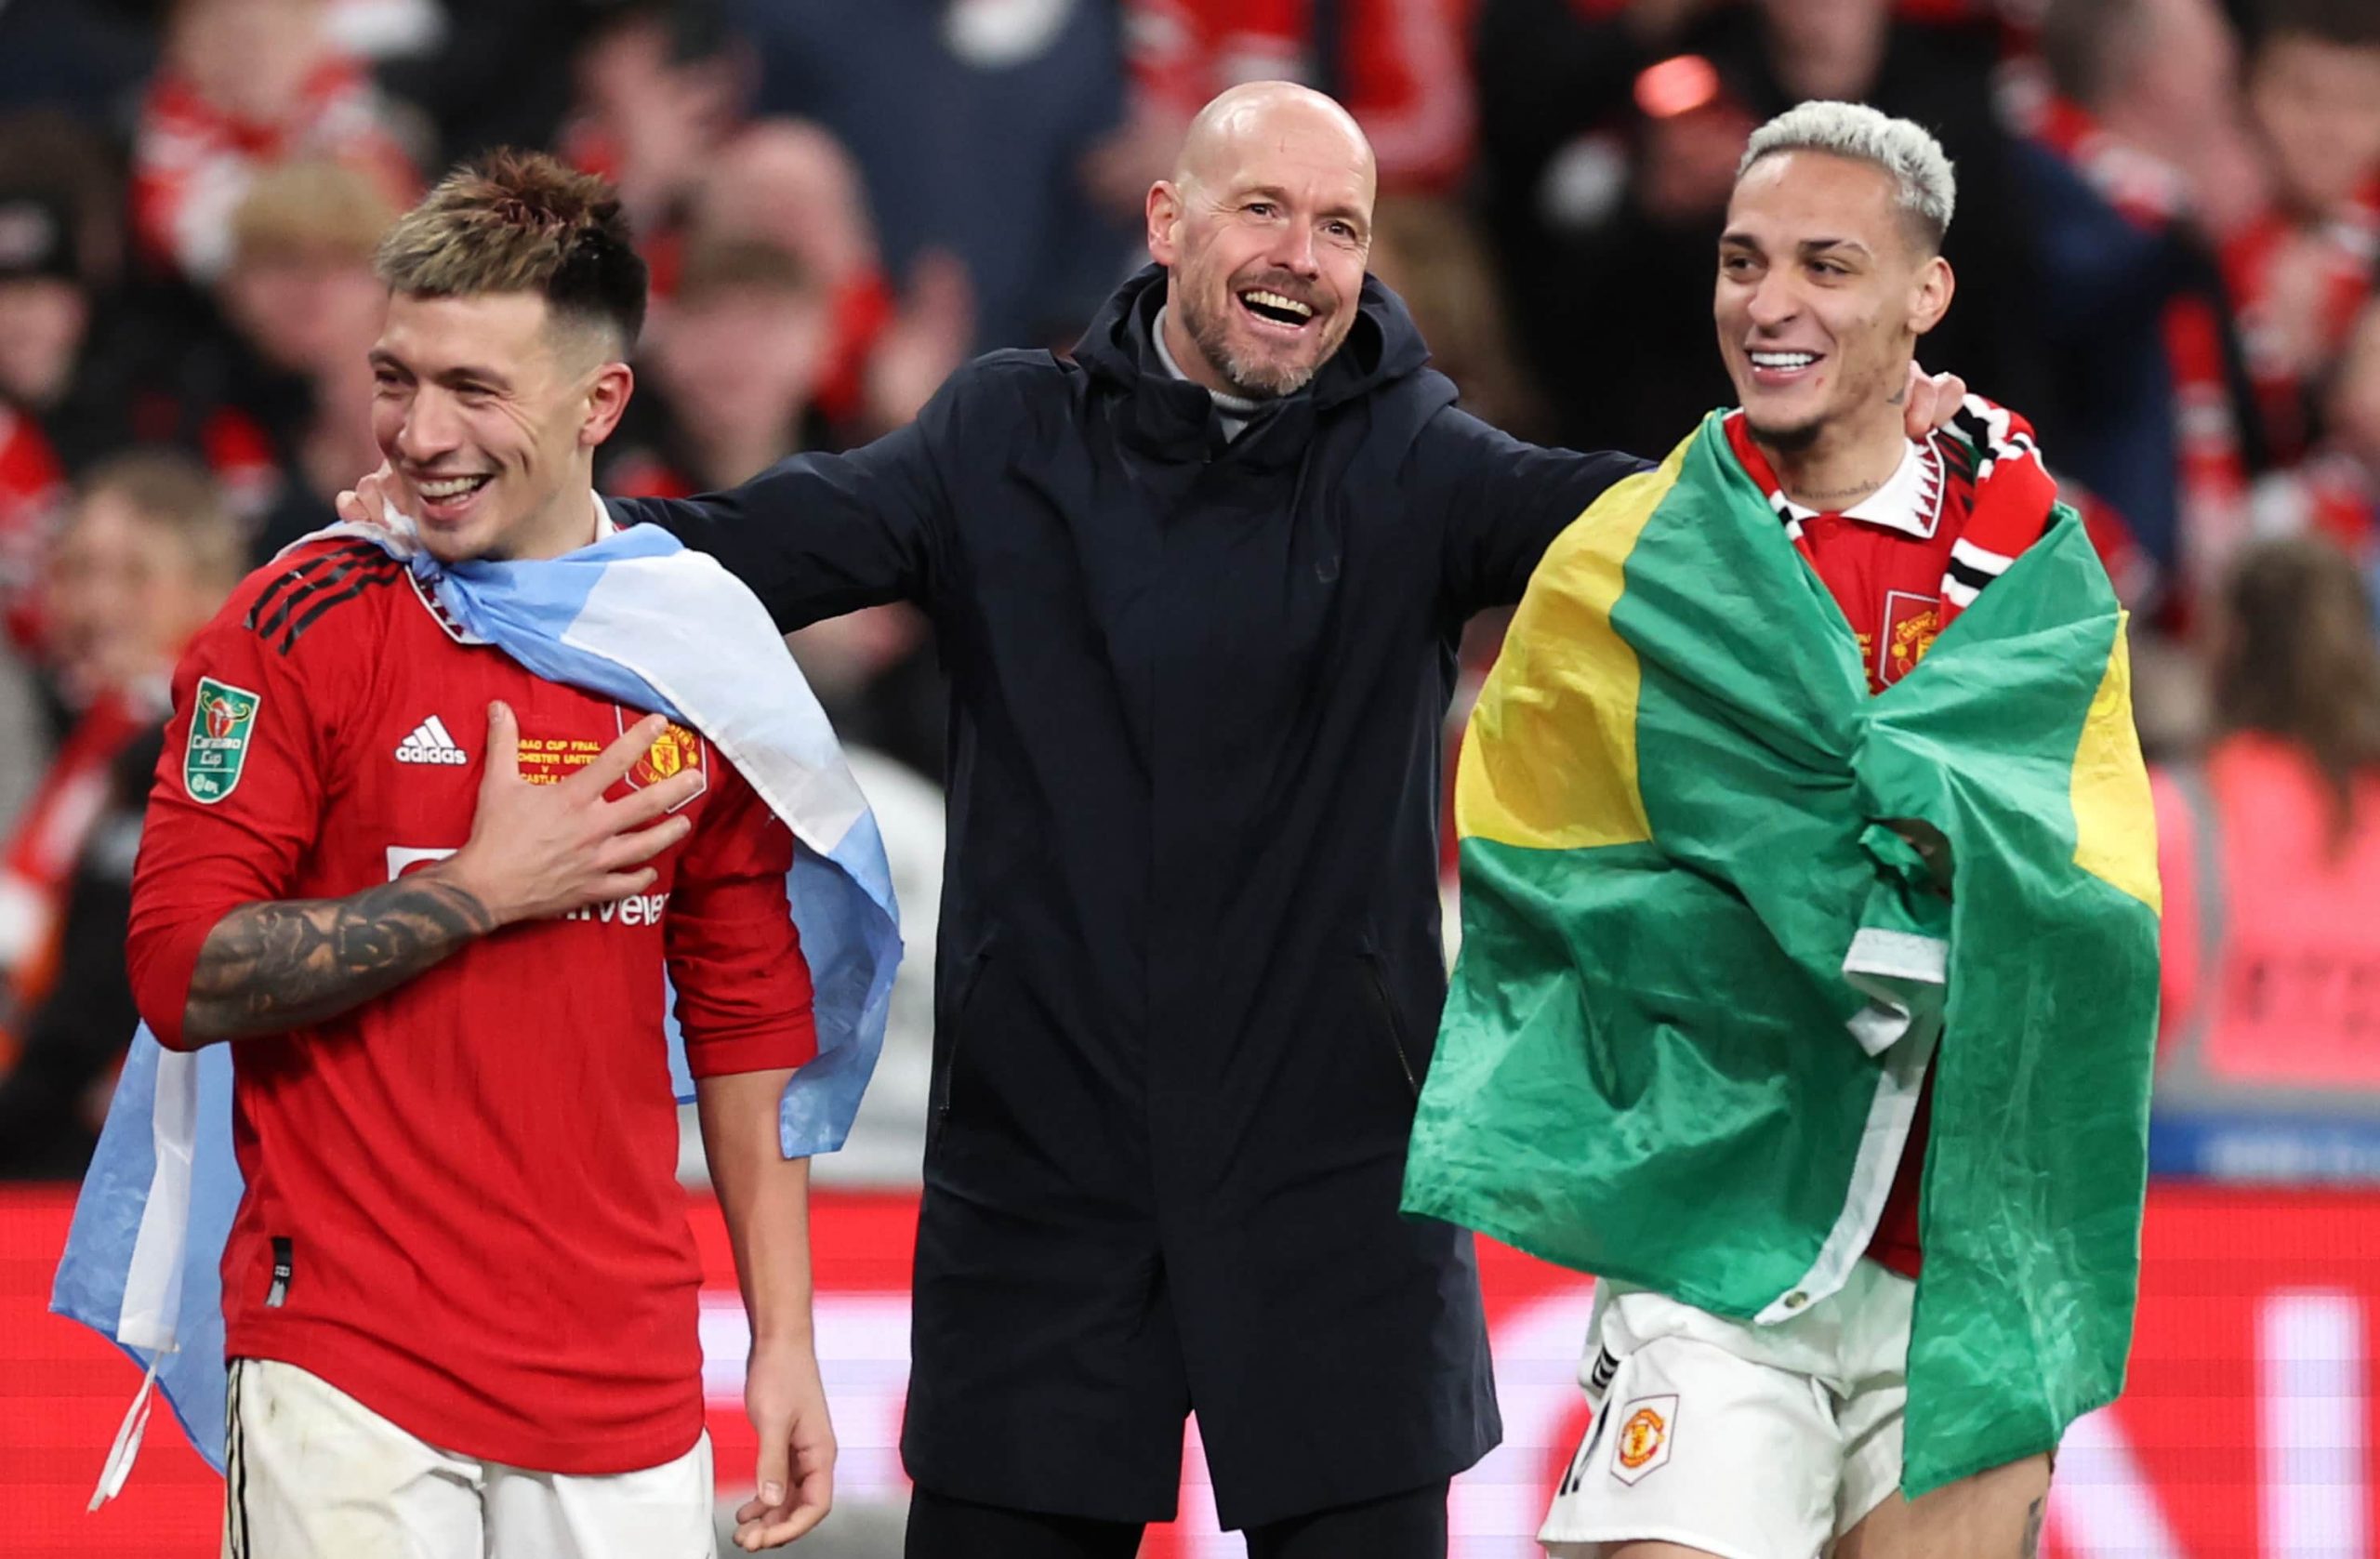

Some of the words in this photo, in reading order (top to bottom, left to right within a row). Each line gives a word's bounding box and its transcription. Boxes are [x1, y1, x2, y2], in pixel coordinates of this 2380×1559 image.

[192, 734, 242, 749] Carabao
[546, 740, 567, 750] CUP
[571, 741, 601, 751] FINAL
[201, 750, 222, 768] Cup
[395, 744, 468, 765] adidas
